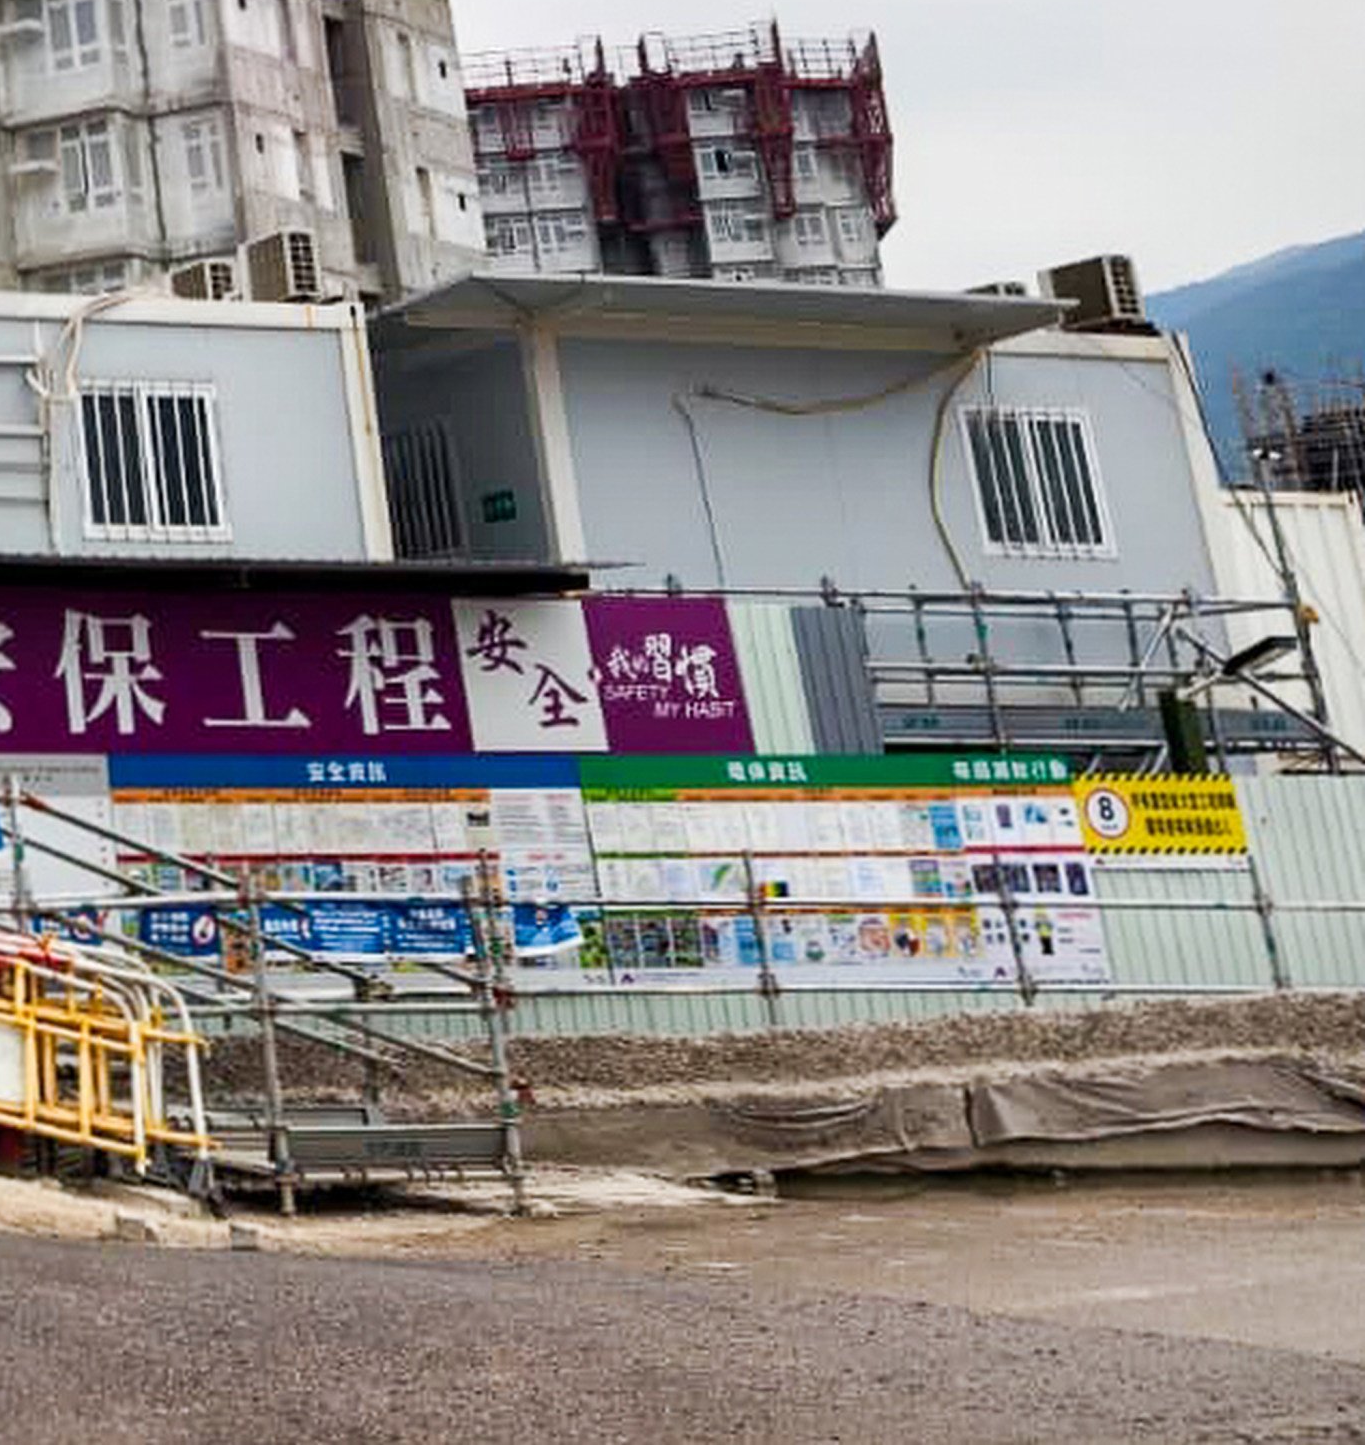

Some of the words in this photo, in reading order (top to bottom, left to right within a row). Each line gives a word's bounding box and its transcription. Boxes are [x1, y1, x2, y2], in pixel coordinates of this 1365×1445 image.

[602, 684, 669, 700] SAFETY
[685, 701, 735, 719] HABIT
[1099, 796, 1115, 821] 8
